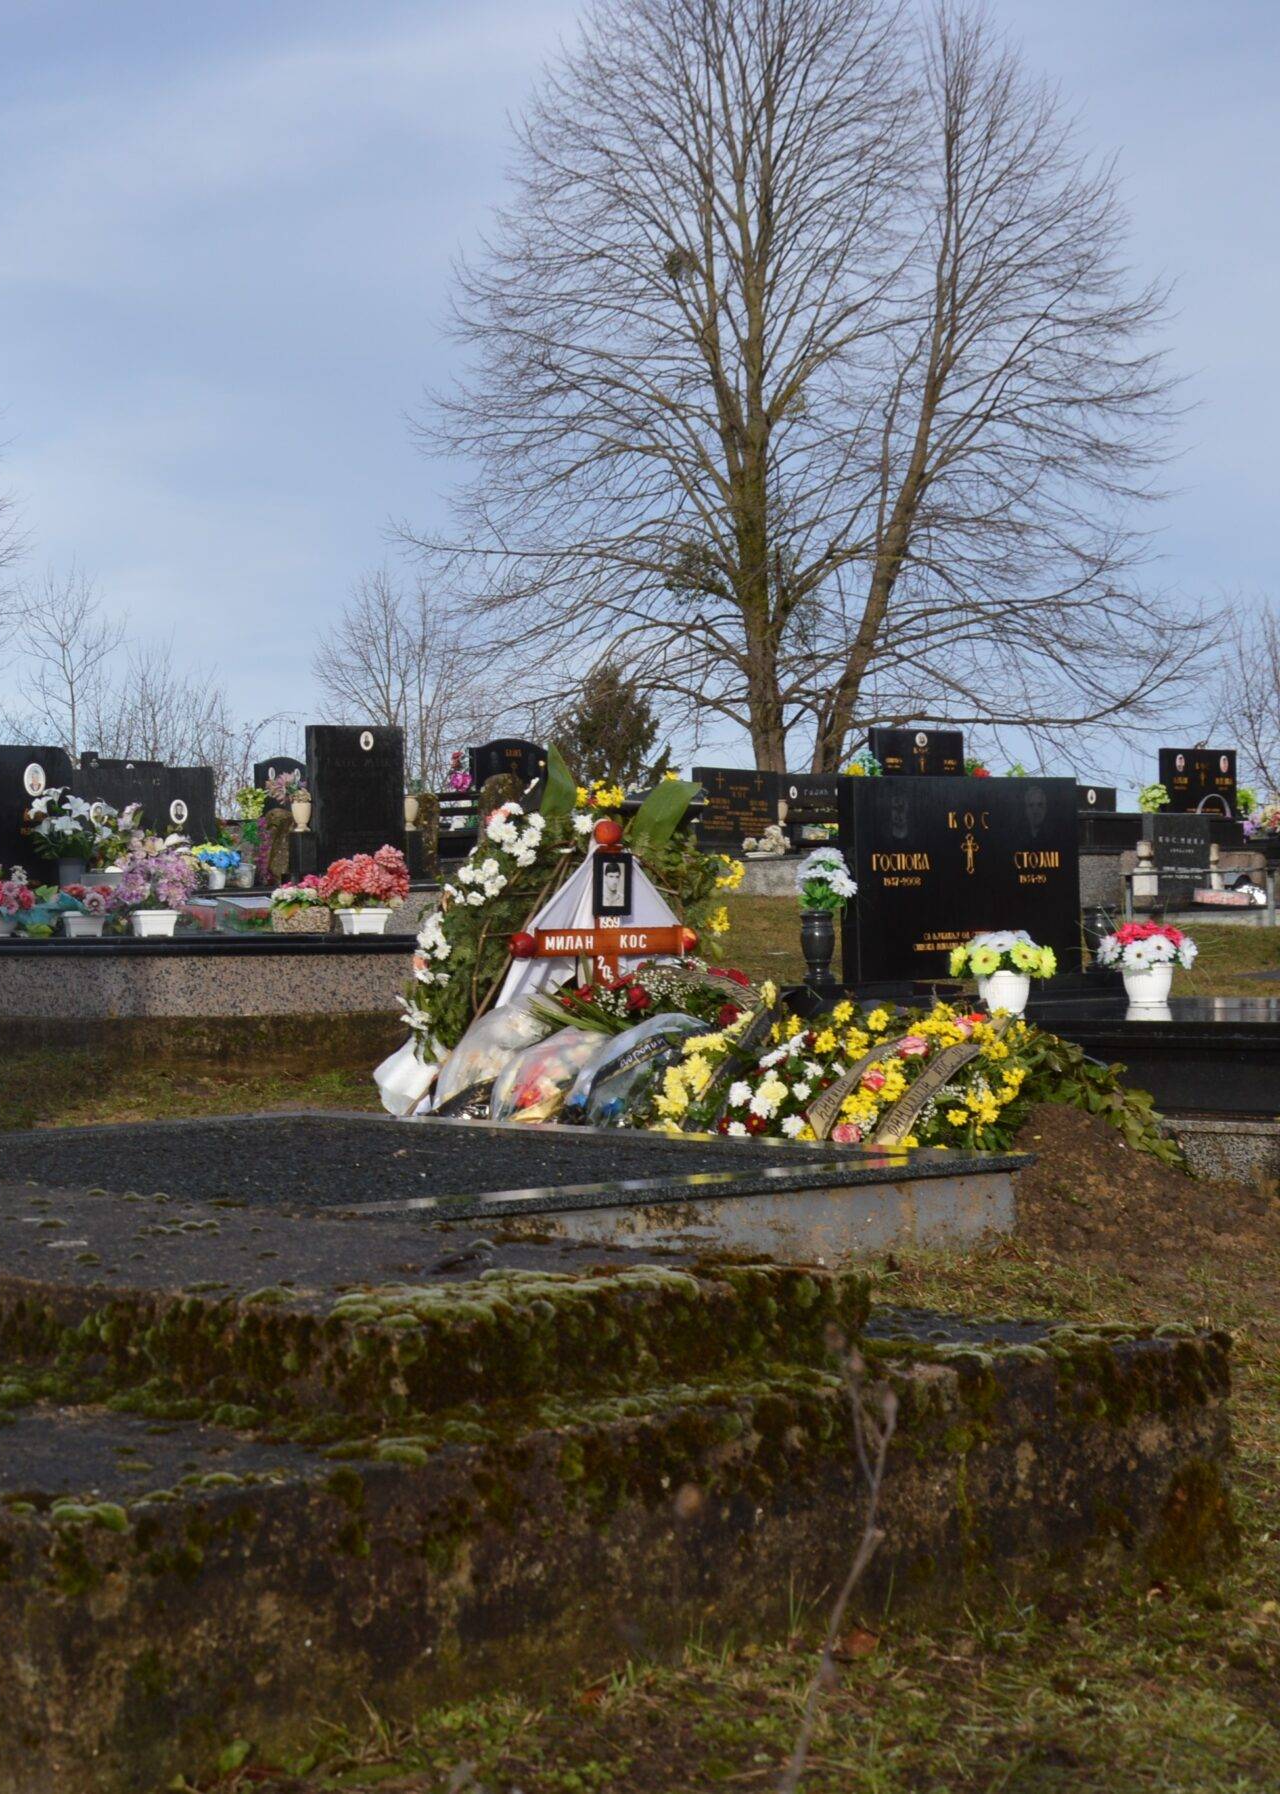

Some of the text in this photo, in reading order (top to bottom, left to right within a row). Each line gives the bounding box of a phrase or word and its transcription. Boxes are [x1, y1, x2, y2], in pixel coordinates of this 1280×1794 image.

[948, 811, 990, 829] КОС
[872, 853, 930, 871] ГОСПОВА
[1013, 851, 1059, 869] СТОЈАН
[545, 934, 648, 950] МИЛАН КОС
